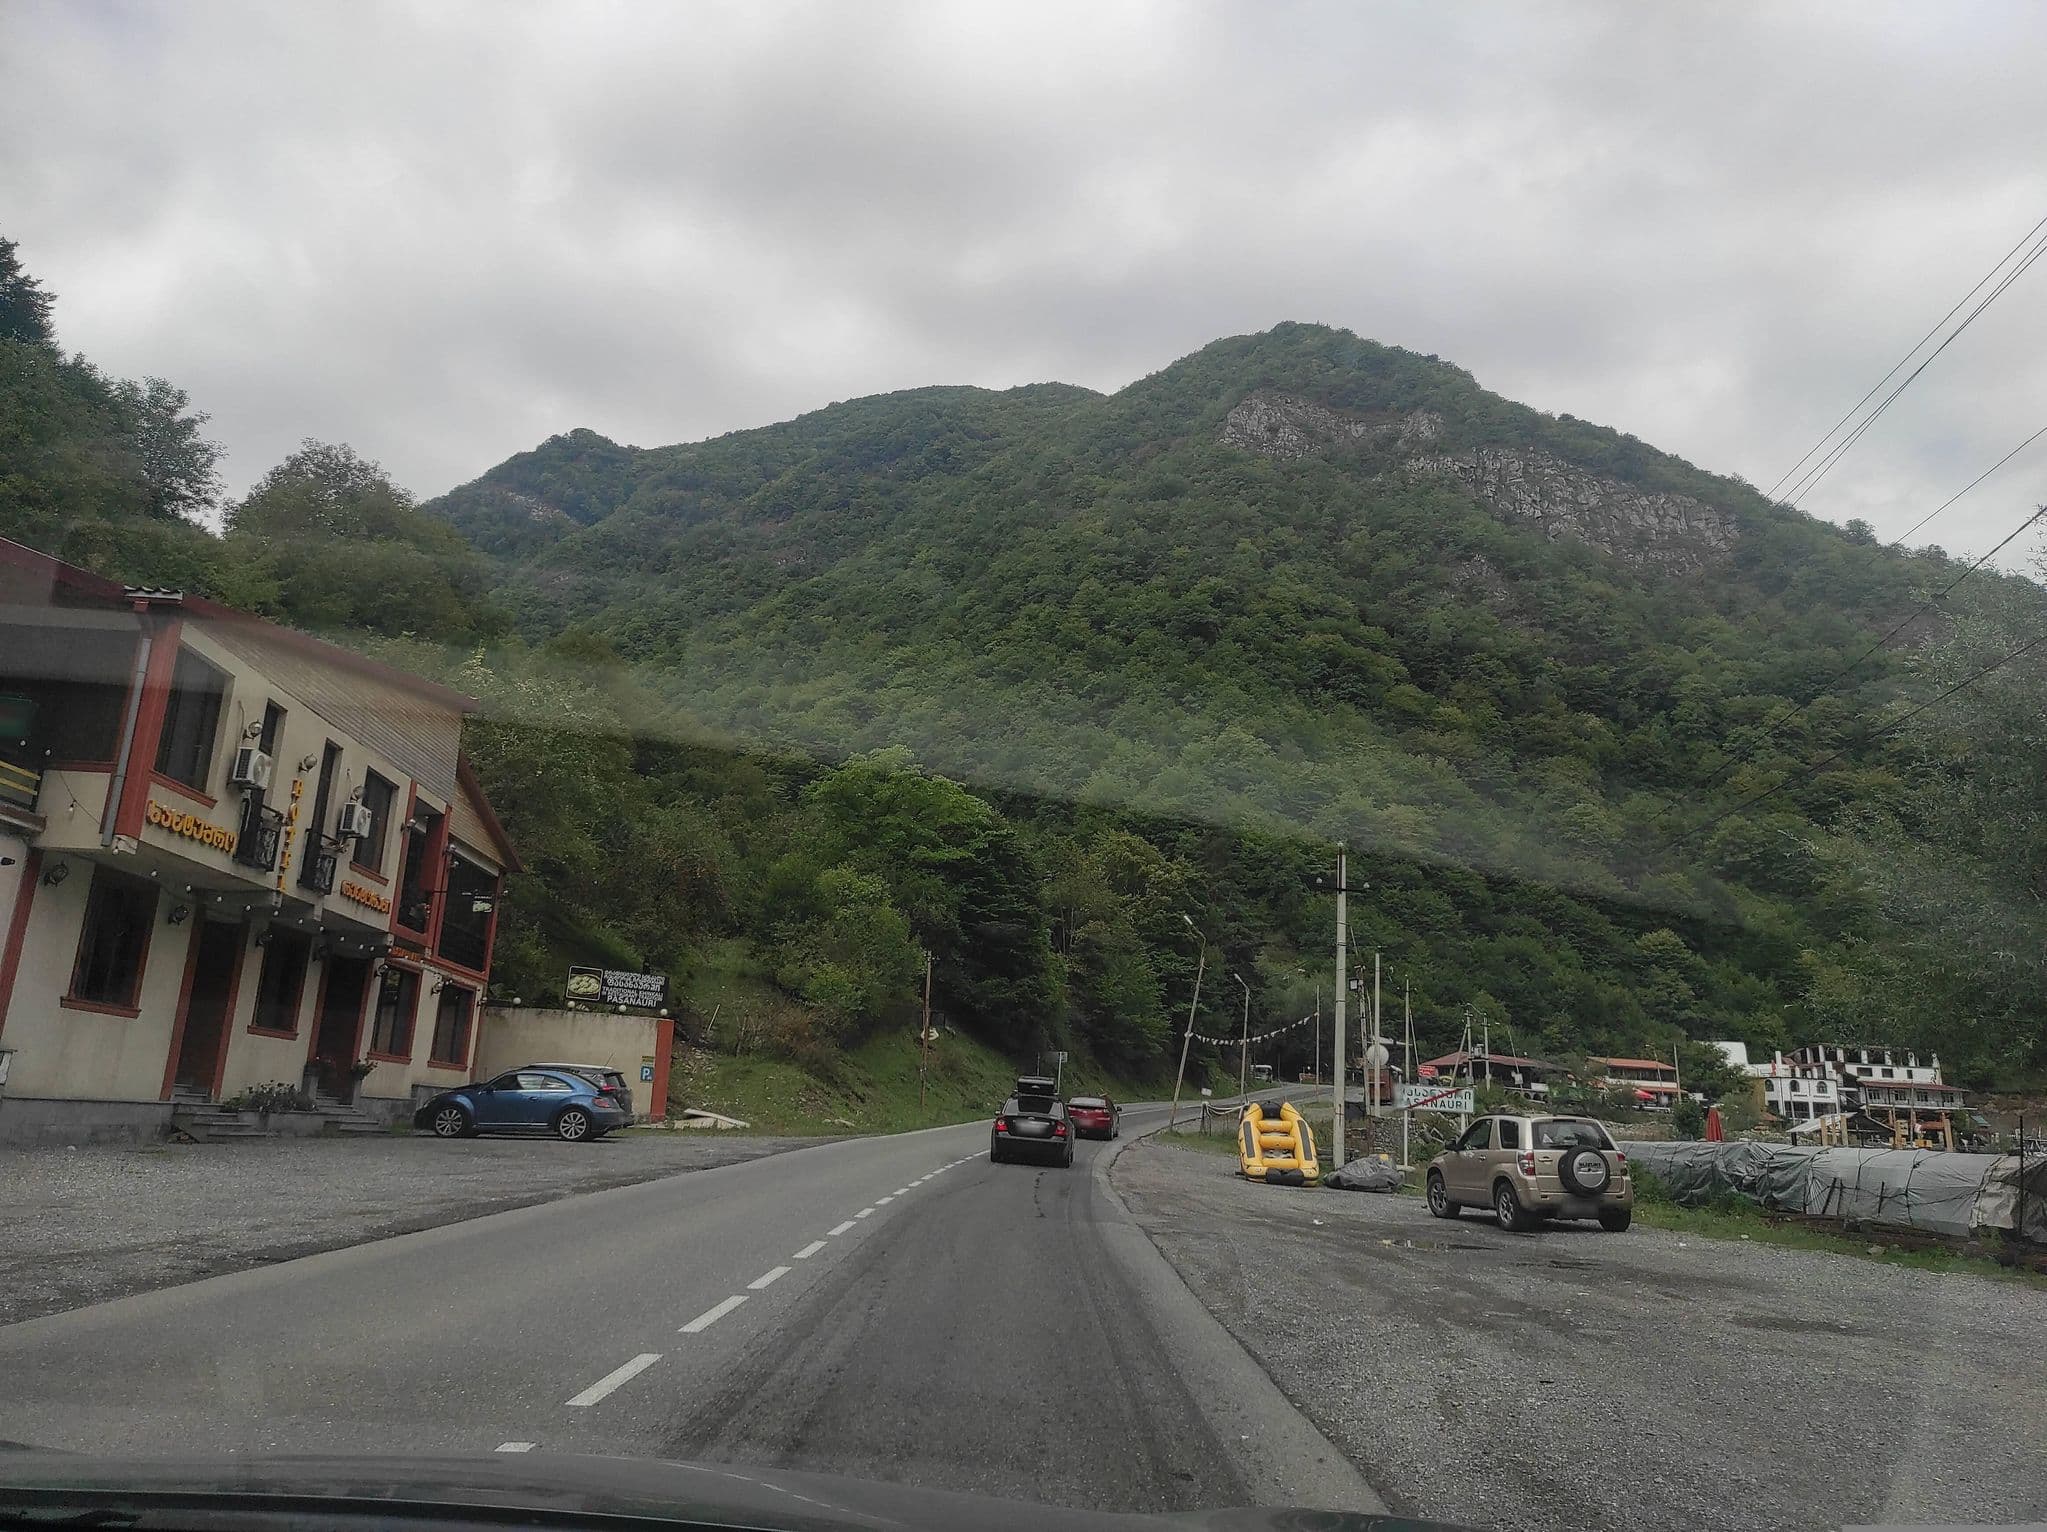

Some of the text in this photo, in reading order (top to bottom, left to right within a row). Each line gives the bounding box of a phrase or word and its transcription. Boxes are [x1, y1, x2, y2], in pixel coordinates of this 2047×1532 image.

[277, 779, 304, 891] HOTEL
[607, 995, 656, 1007] PASANAURI
[1400, 1097, 1467, 1111] ASANAURI
